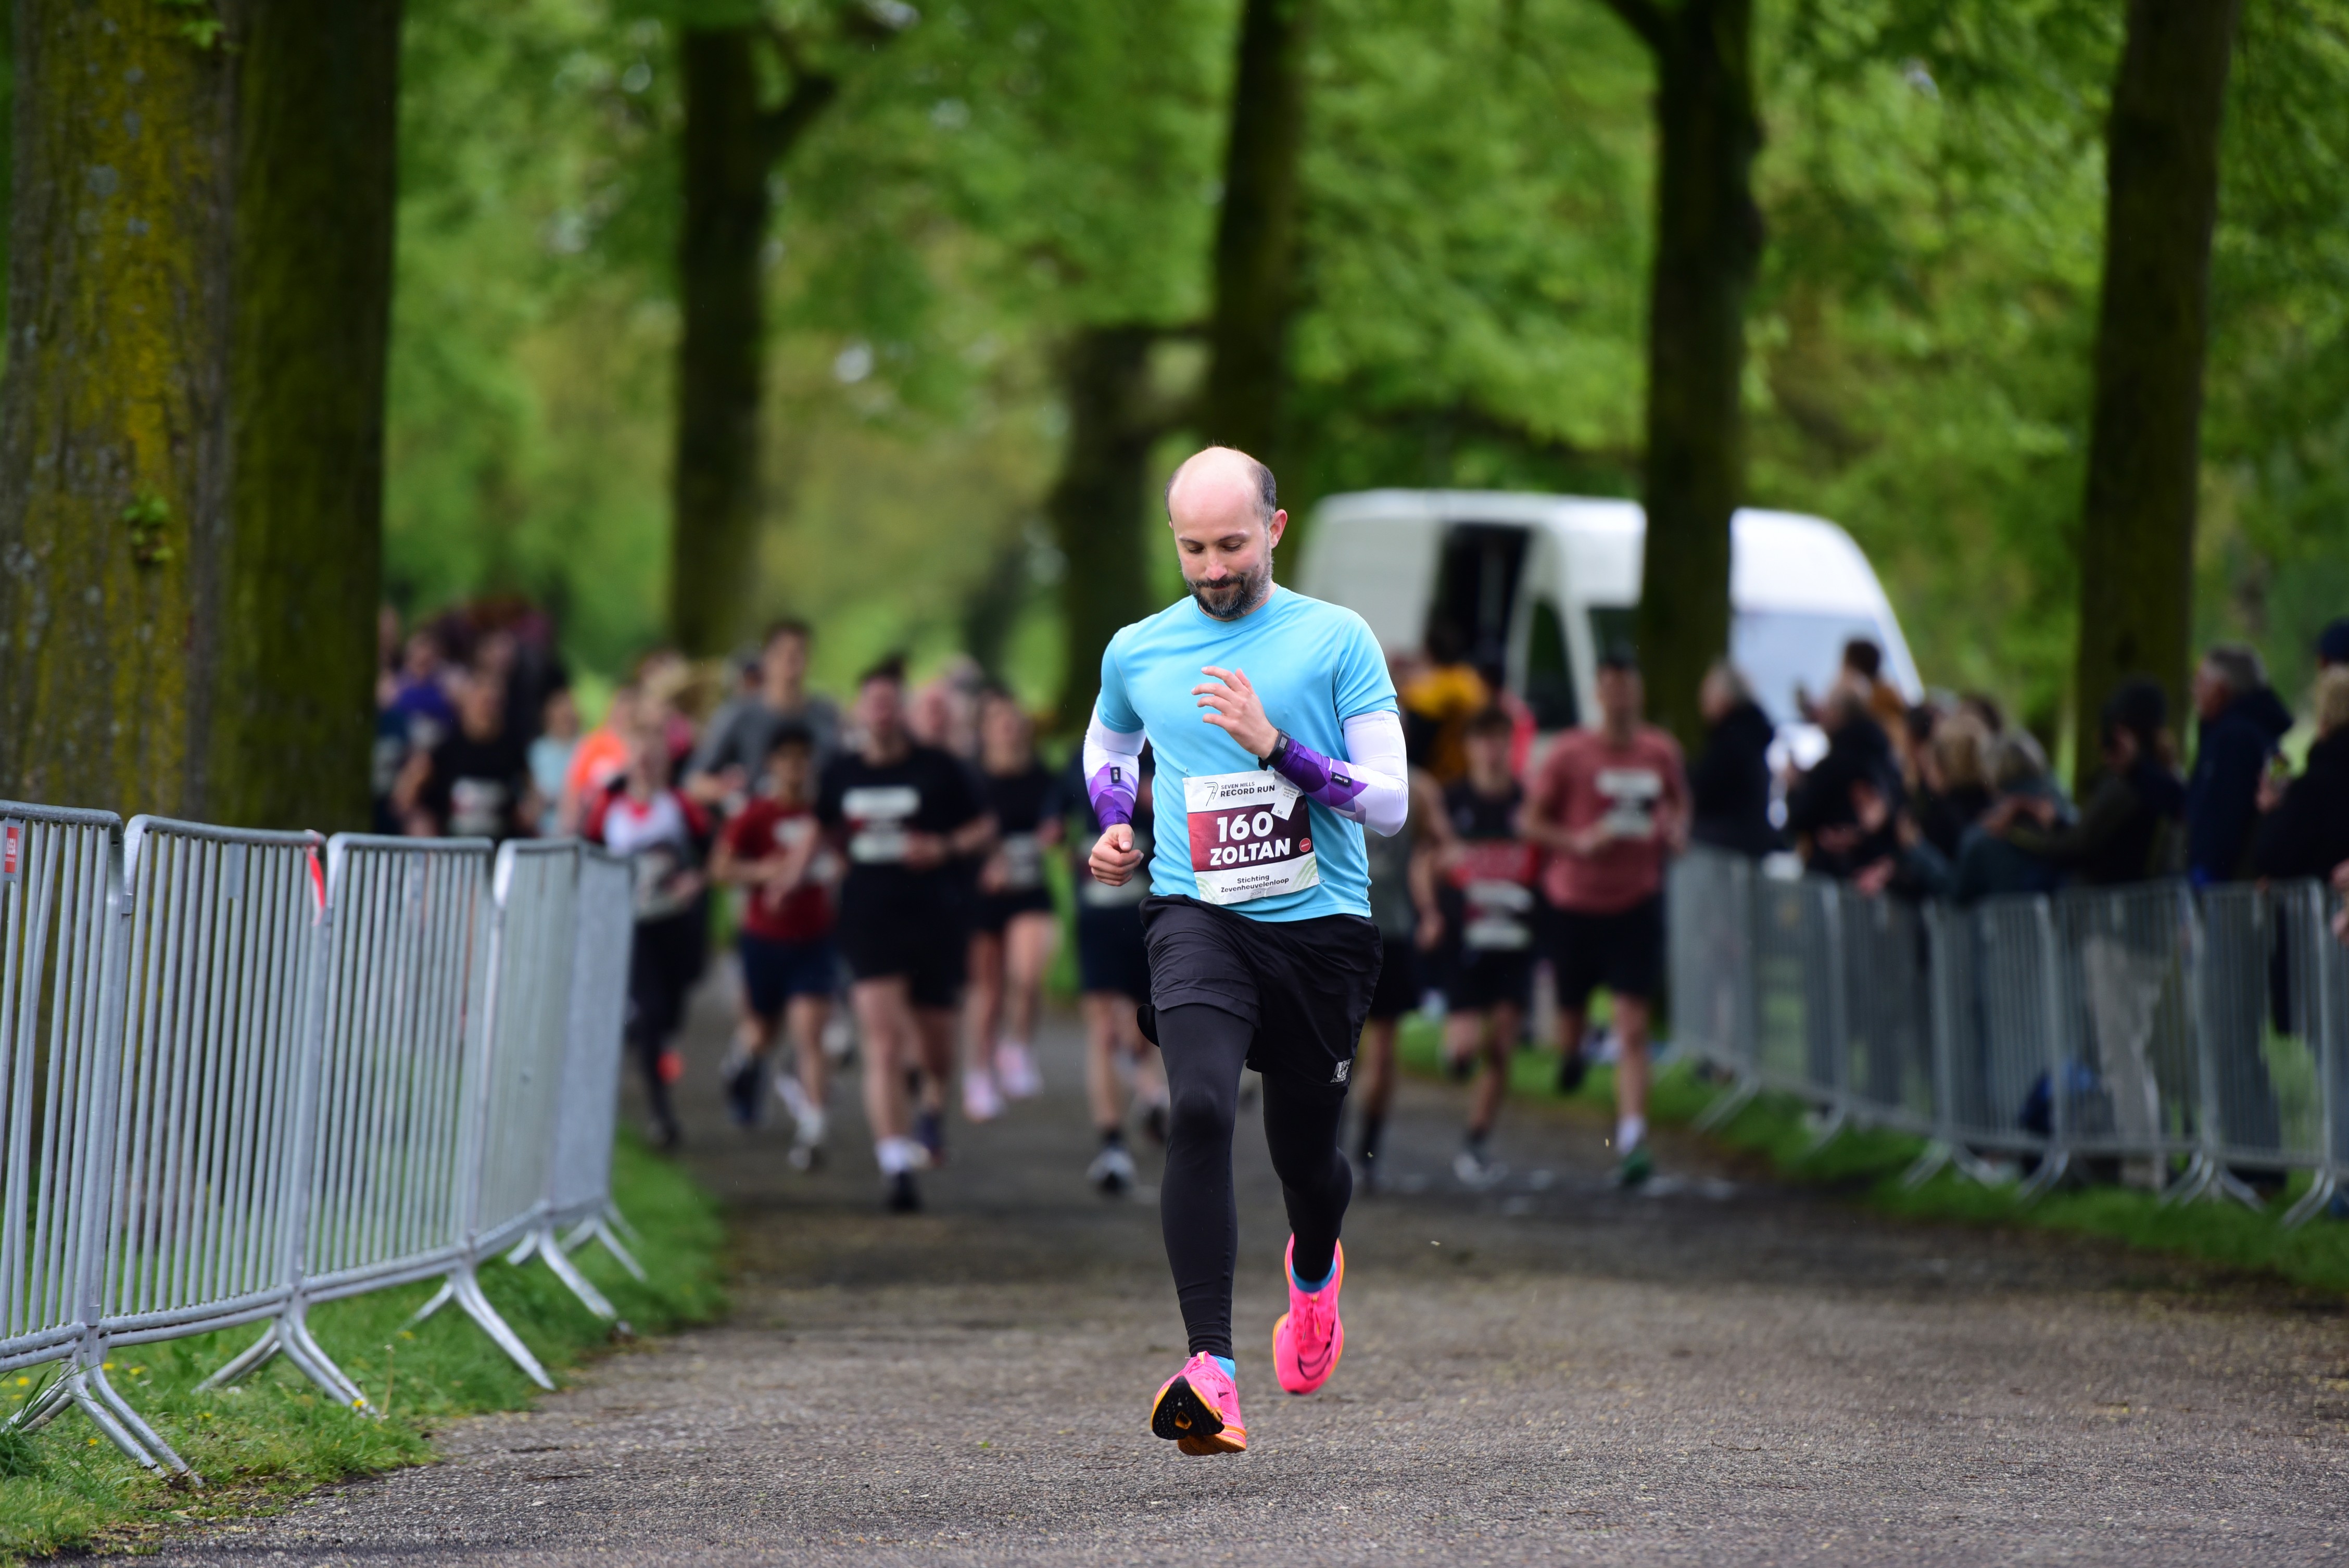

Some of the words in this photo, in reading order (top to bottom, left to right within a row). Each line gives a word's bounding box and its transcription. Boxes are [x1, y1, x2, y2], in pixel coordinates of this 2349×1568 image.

[1220, 788, 1255, 798] RECORD
[1257, 785, 1275, 793] RUN
[1217, 811, 1273, 842] 160
[1210, 838, 1291, 866] ZOLTAN
[1221, 877, 1290, 893] Zevenheuvelenloop
[1237, 875, 1270, 884] Stichting
